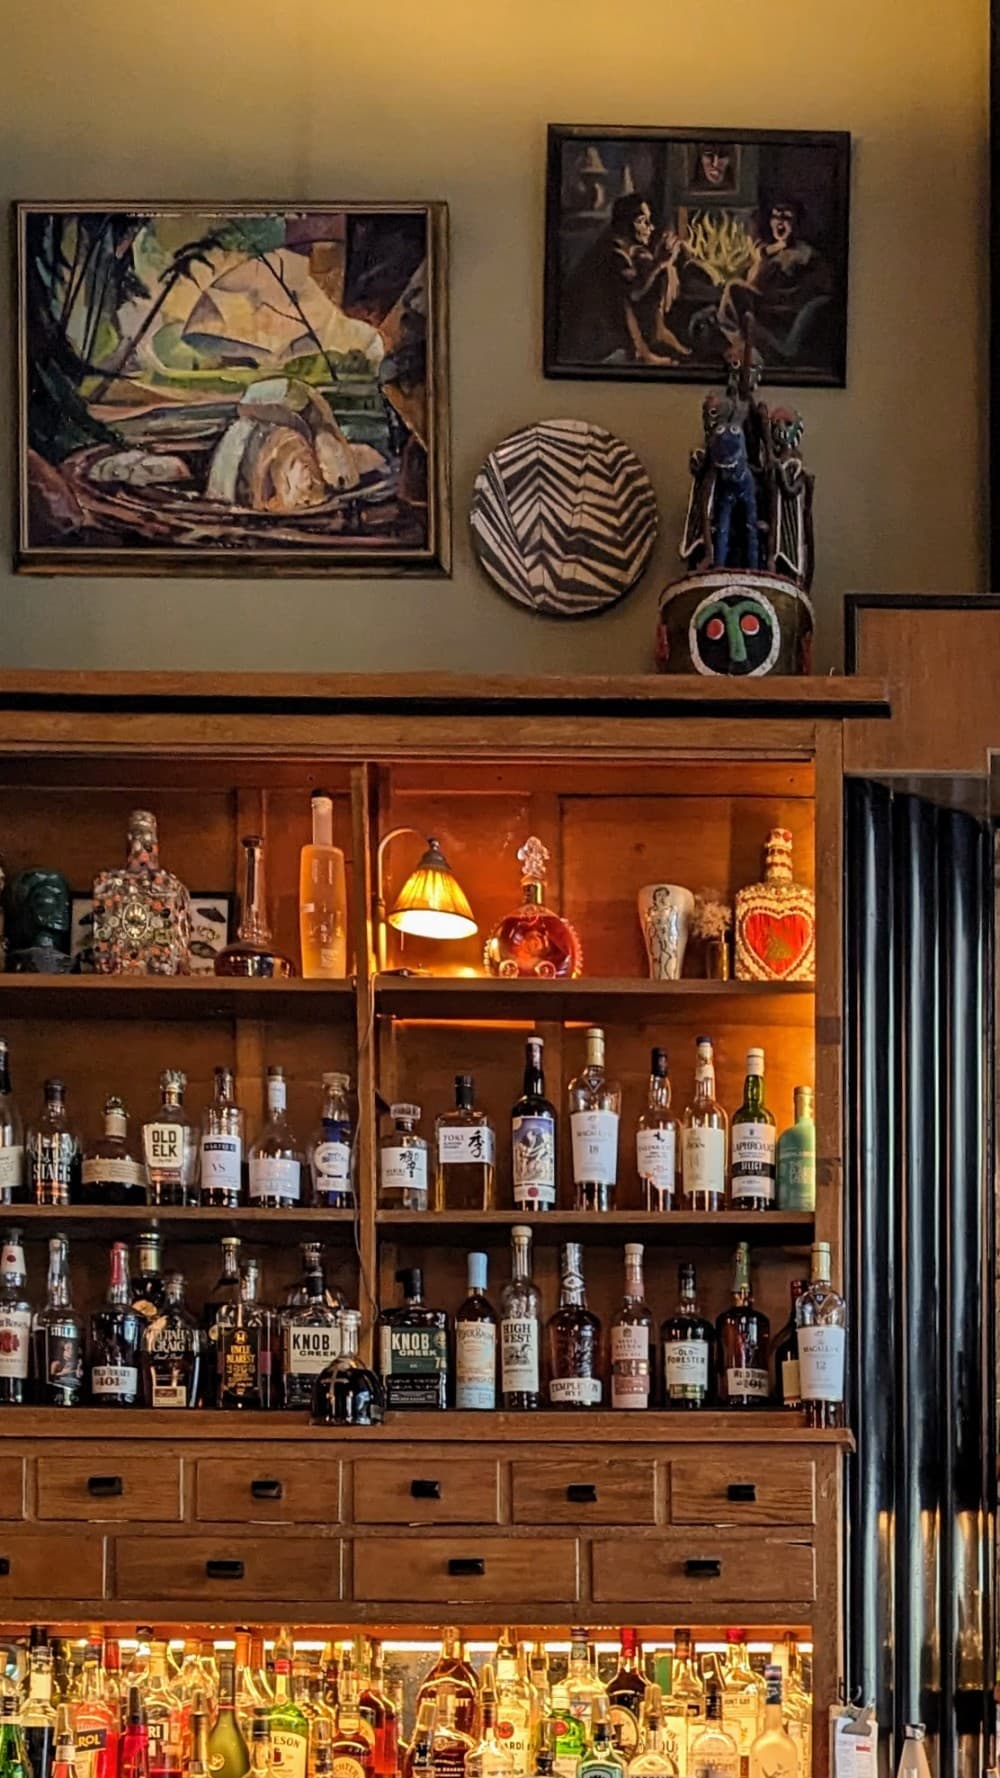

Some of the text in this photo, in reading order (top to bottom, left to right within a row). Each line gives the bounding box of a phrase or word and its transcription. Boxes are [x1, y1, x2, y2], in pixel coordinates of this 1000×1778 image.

[152, 1130, 177, 1143] OLD
[152, 1144, 177, 1157] ELK
[503, 1324, 531, 1334] HIGH
[293, 1334, 330, 1350] KNOB
[392, 1333, 430, 1350] KNOB
[504, 1334, 531, 1344] WEST
[98, 1376, 119, 1386] 101
[78, 1734, 101, 1747] ROL
[273, 1735, 300, 1748] ESON
